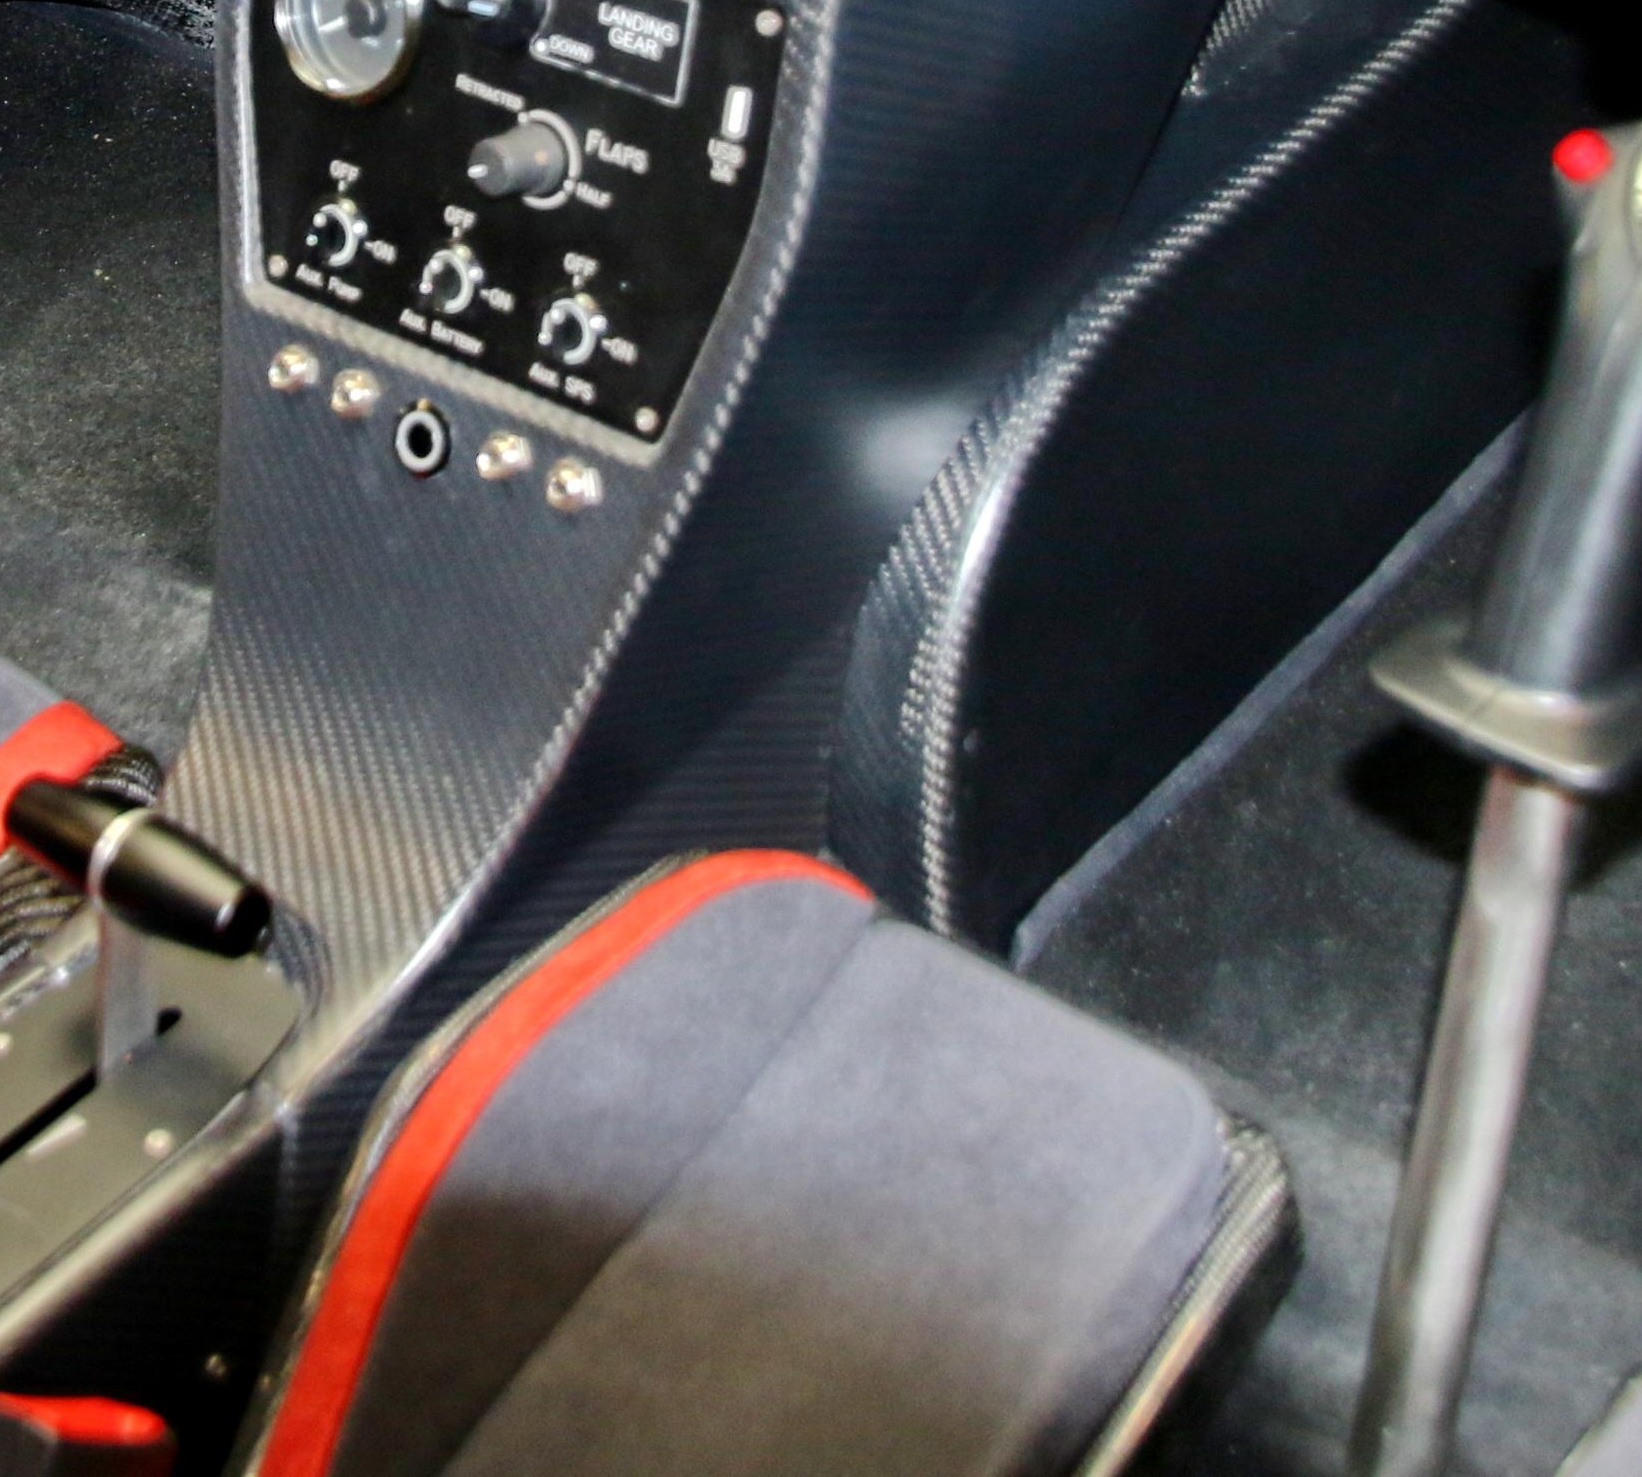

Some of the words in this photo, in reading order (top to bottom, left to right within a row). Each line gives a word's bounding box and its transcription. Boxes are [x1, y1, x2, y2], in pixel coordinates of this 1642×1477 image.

[598, 1, 679, 47] LANDING
[548, 34, 595, 64] DOWN
[608, 25, 664, 61] GEAR
[708, 138, 745, 170] USB
